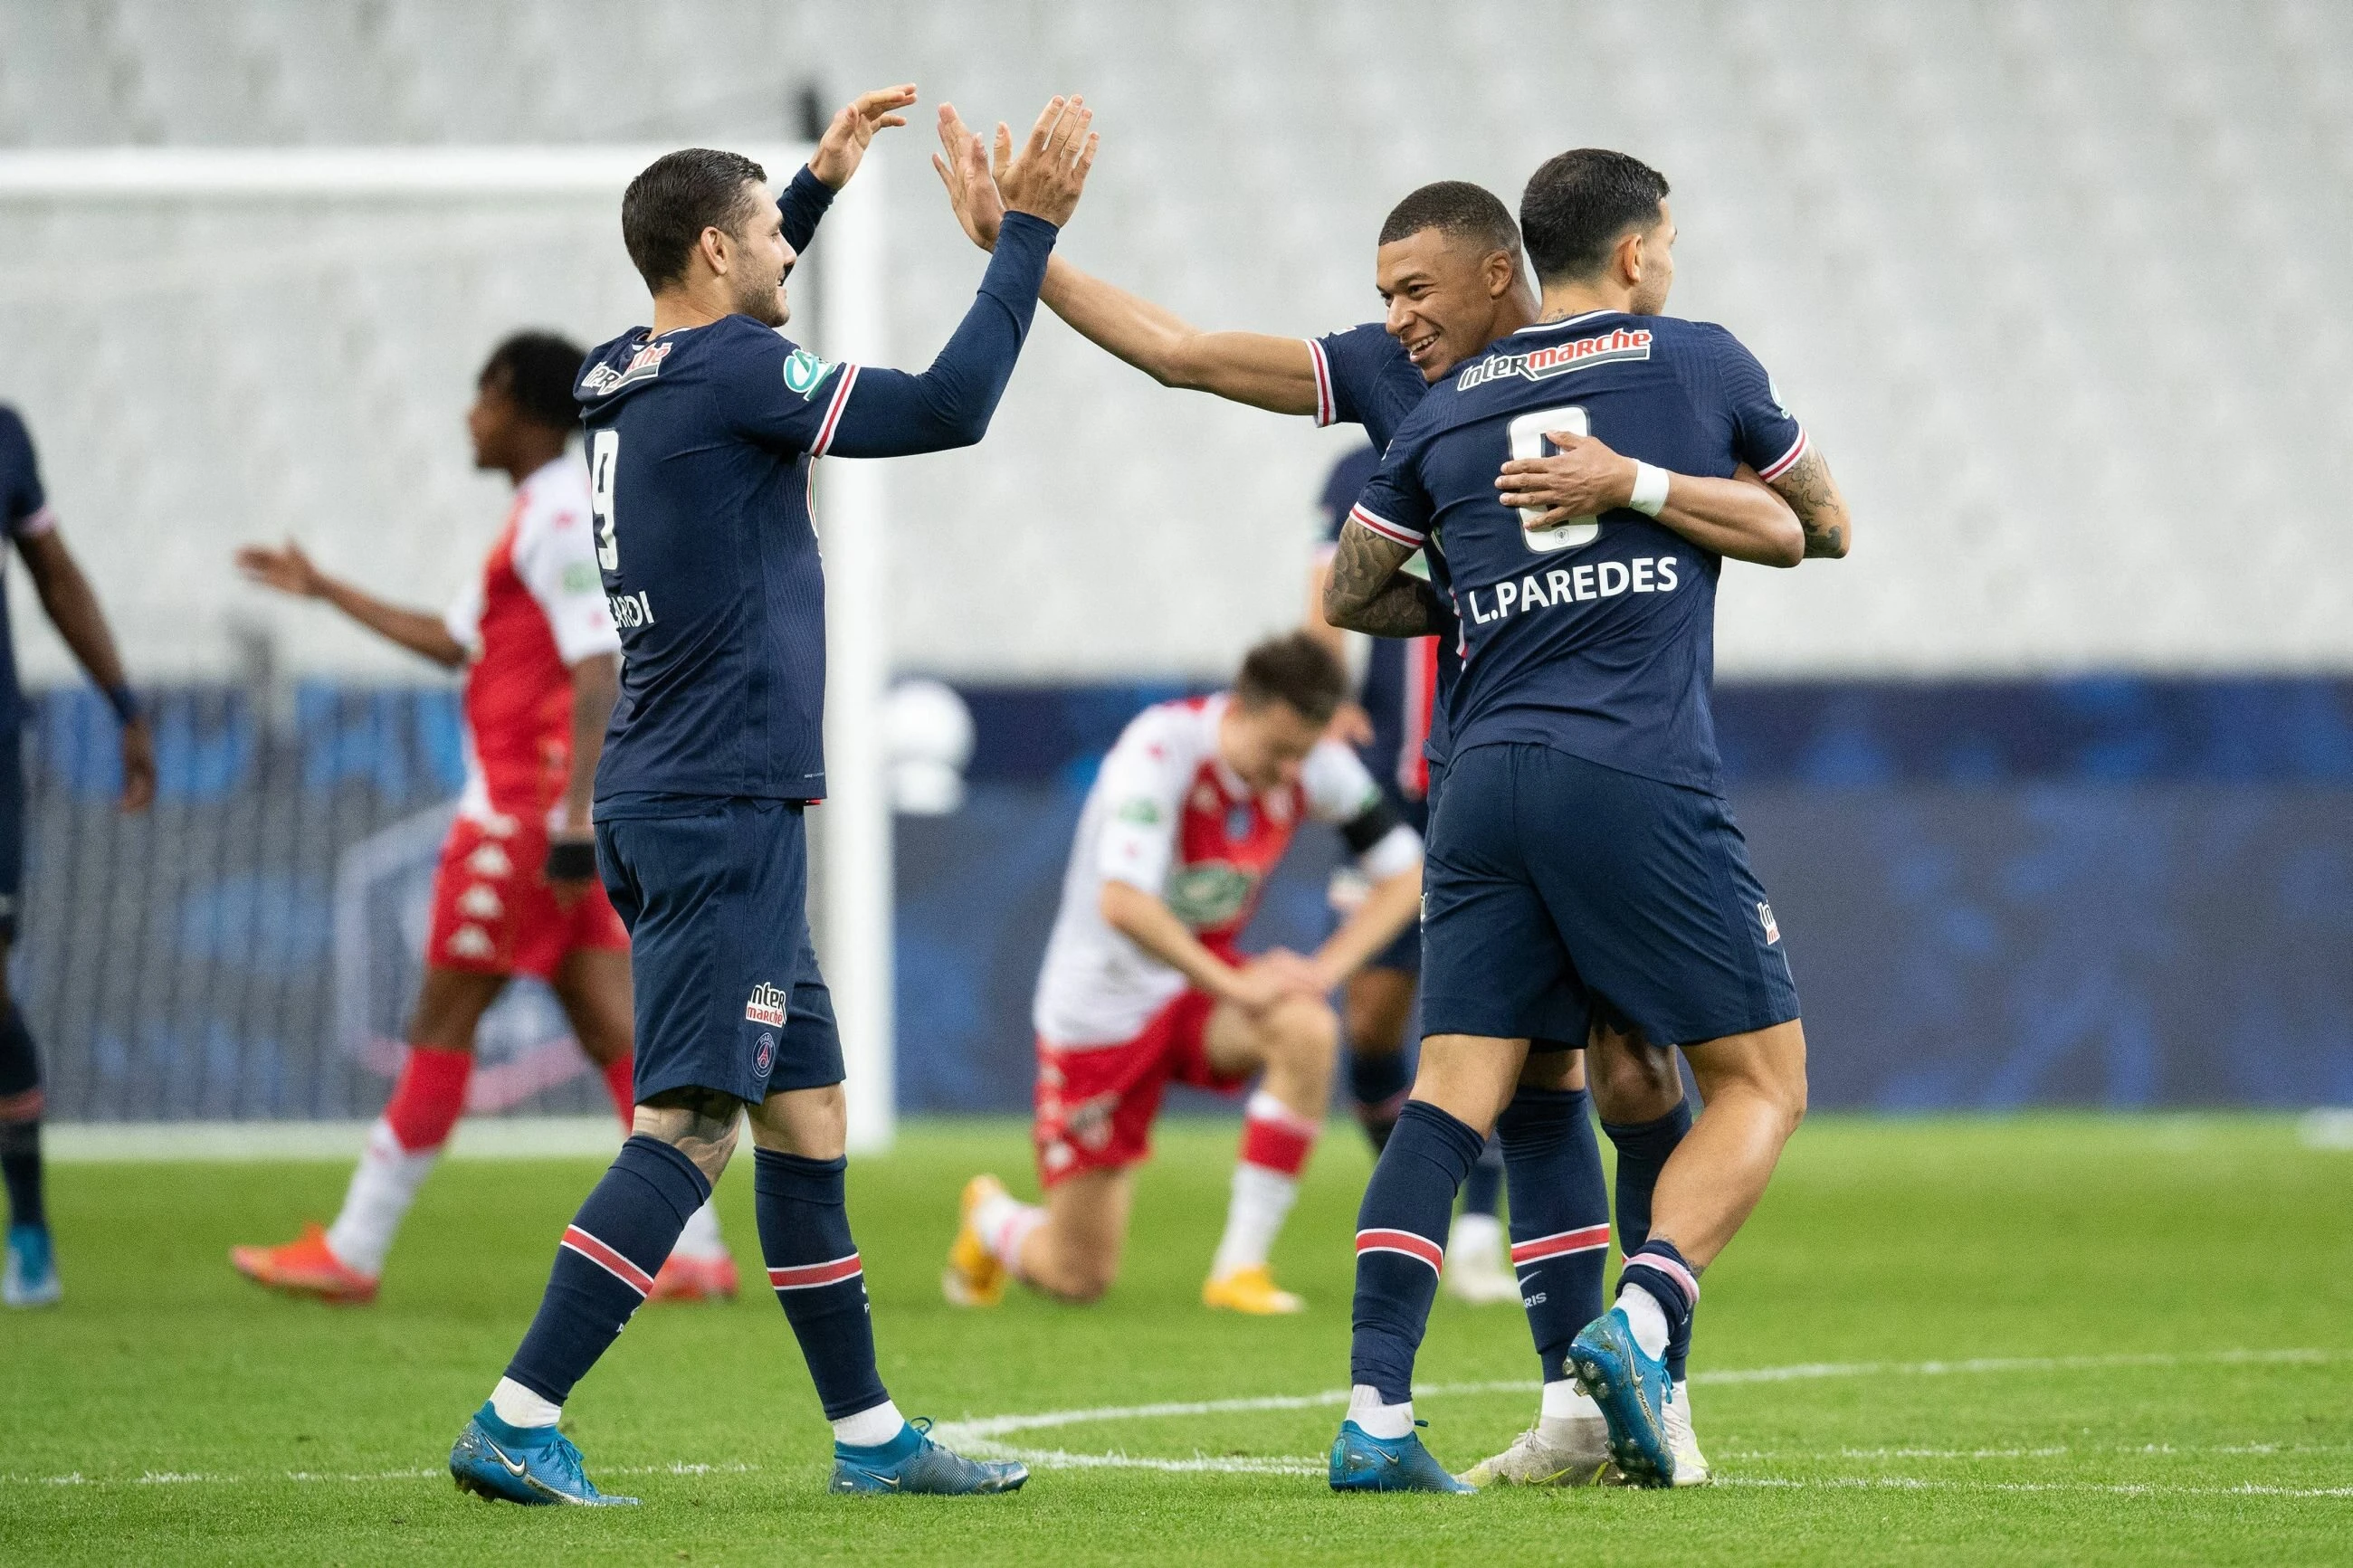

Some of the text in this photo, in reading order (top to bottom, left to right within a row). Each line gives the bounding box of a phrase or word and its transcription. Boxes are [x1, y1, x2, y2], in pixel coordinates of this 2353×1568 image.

[591, 430, 619, 570] 9
[1469, 556, 1678, 624] L.PAREDES
[1524, 1292, 1547, 1308] RIS
